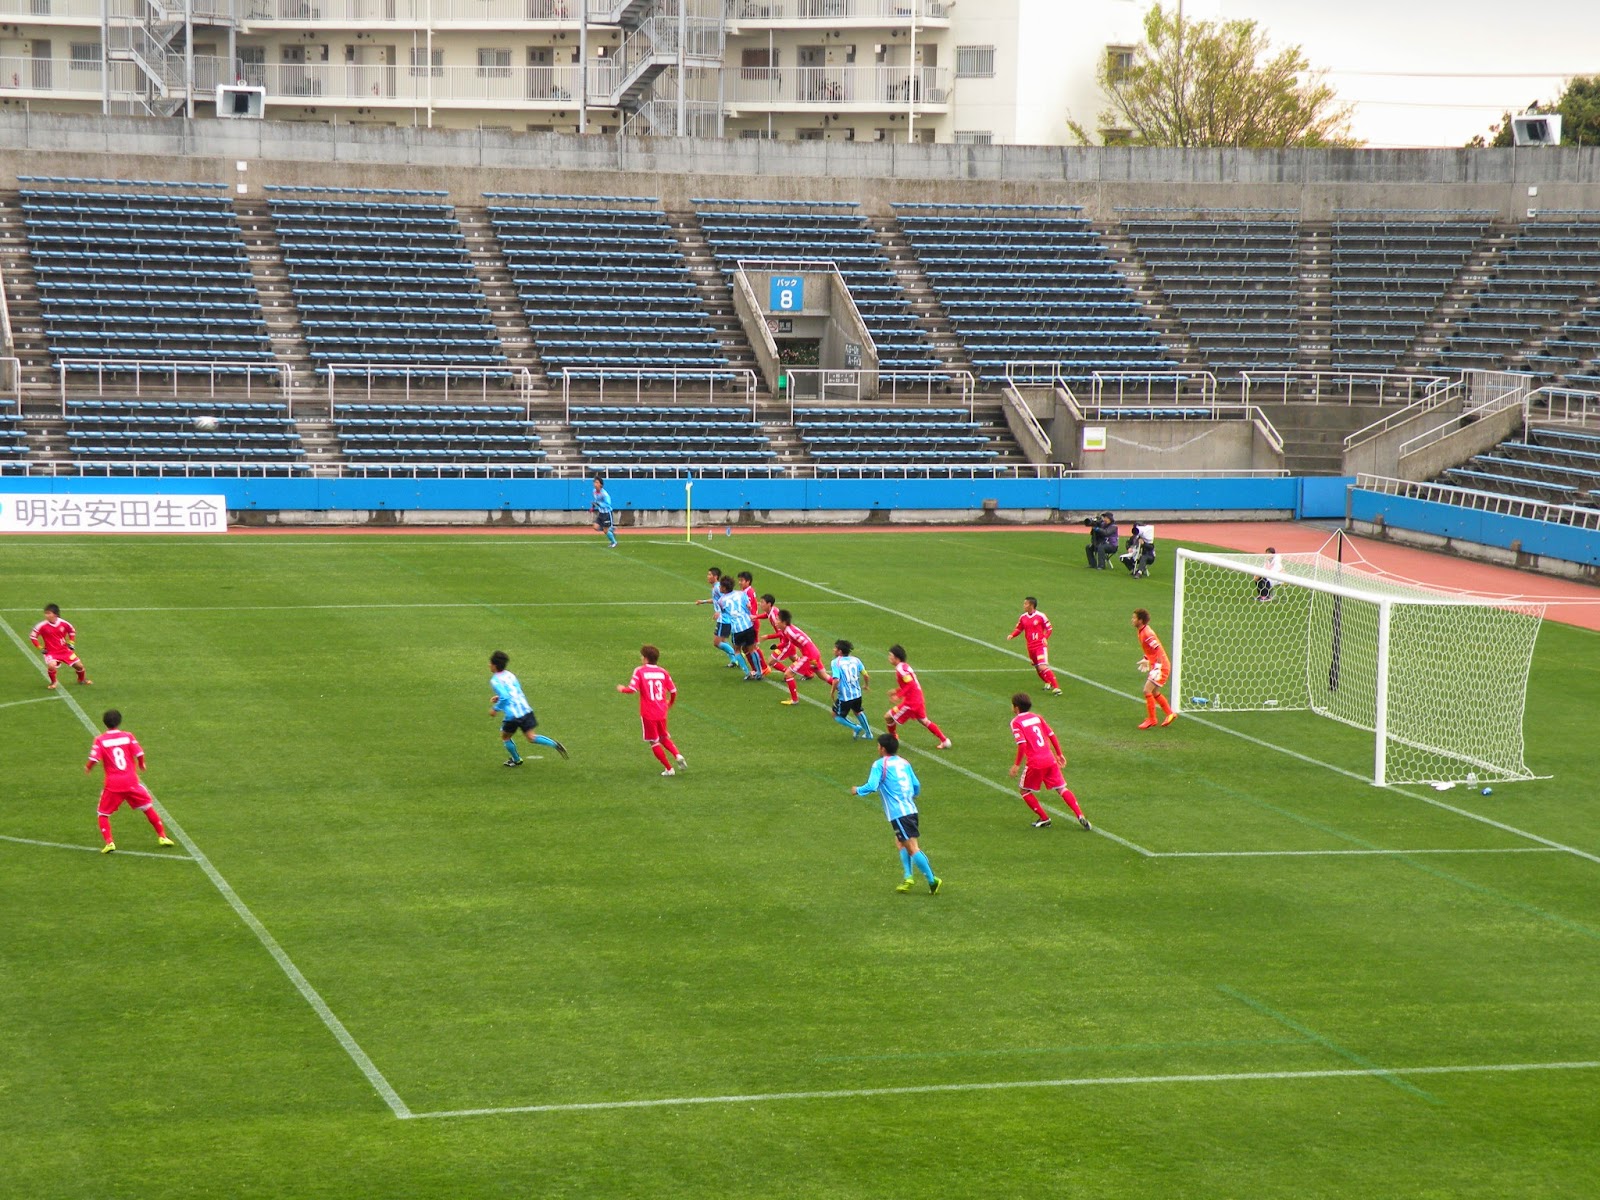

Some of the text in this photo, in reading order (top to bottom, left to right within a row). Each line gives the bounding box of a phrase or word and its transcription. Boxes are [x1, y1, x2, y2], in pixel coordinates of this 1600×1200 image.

[781, 289, 792, 308] 8
[15, 499, 218, 527] 明治安田生命
[648, 680, 662, 701] 13
[1032, 725, 1045, 747] 3
[112, 747, 127, 771] 8
